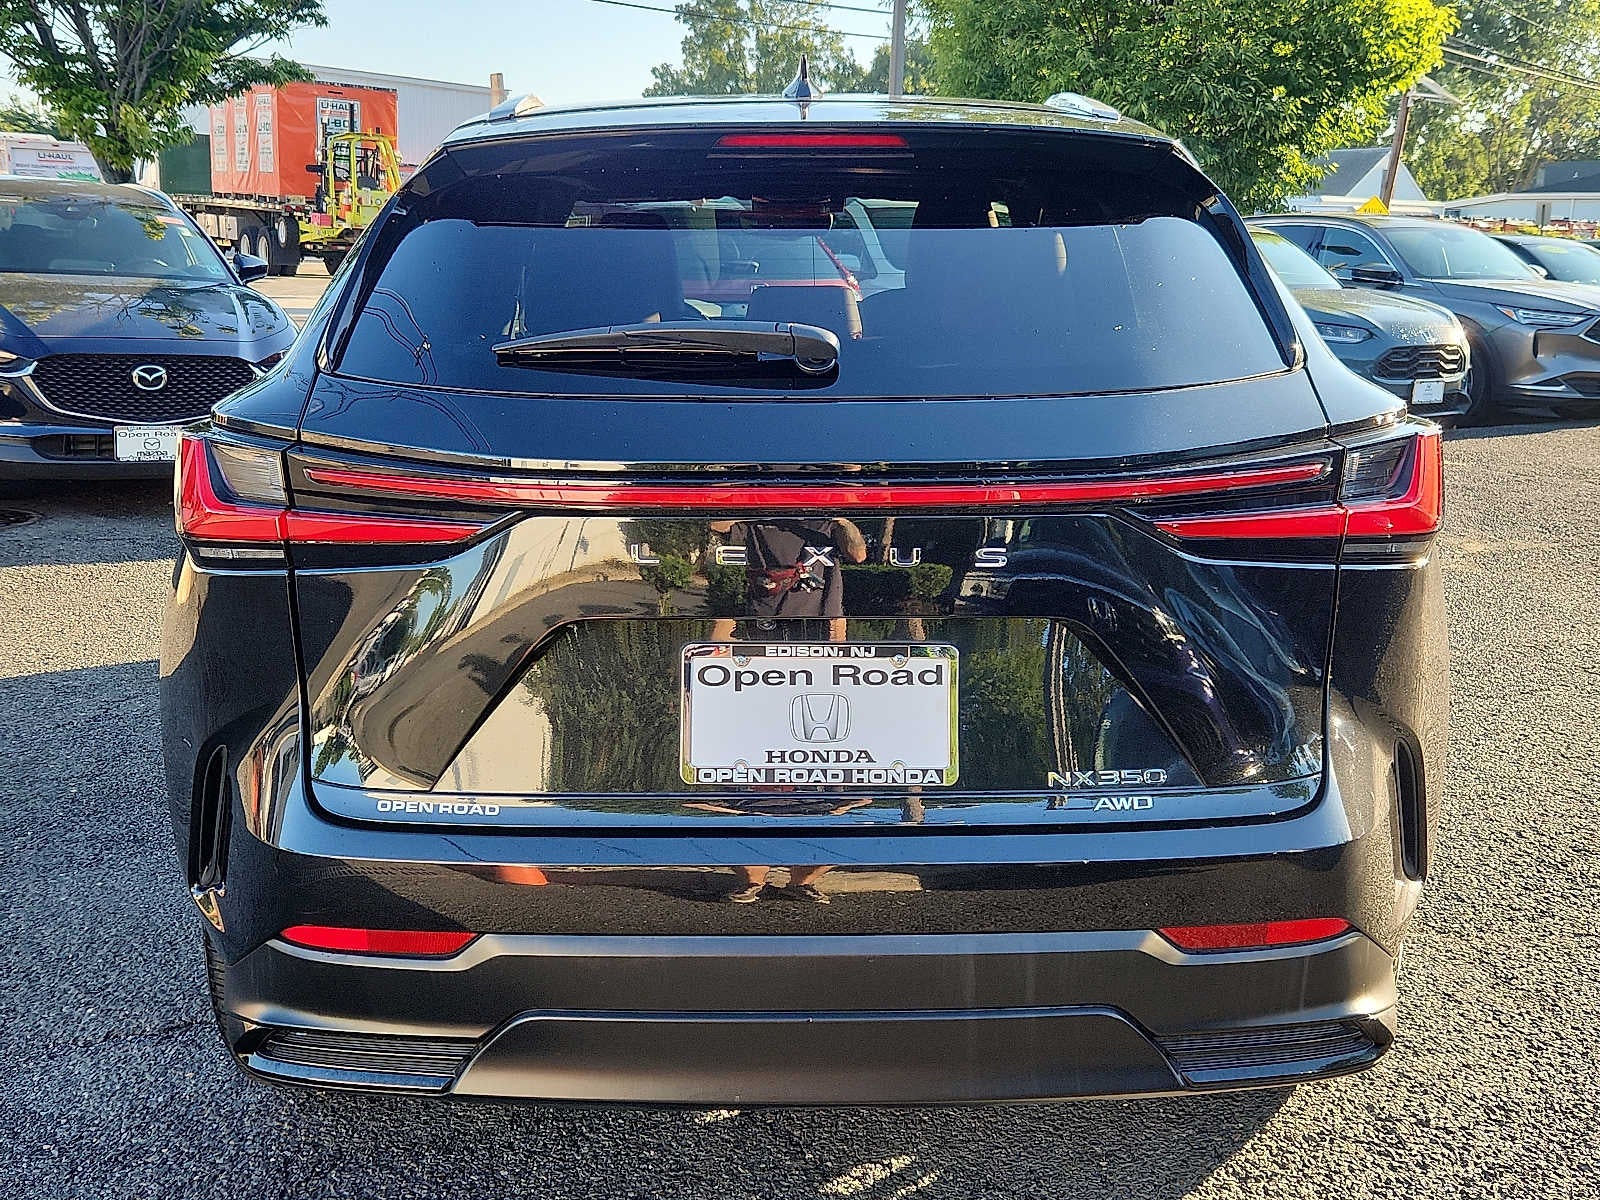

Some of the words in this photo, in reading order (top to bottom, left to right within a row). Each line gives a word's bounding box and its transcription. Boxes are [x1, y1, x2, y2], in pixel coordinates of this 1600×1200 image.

[321, 101, 357, 111] U-HAU
[630, 544, 1008, 568] LEXUS
[765, 646, 844, 657] EDISON,
[850, 646, 876, 657] NJ
[697, 664, 813, 691] Open
[832, 664, 943, 686] Road
[765, 750, 876, 764] HONDA
[699, 769, 765, 784] OPEN
[774, 769, 845, 784] ROAD
[852, 769, 942, 784] HONDA
[1048, 768, 1167, 787] NX350
[377, 800, 434, 814] OPEN
[439, 803, 500, 817] ROAD
[1093, 796, 1153, 811] AWD
